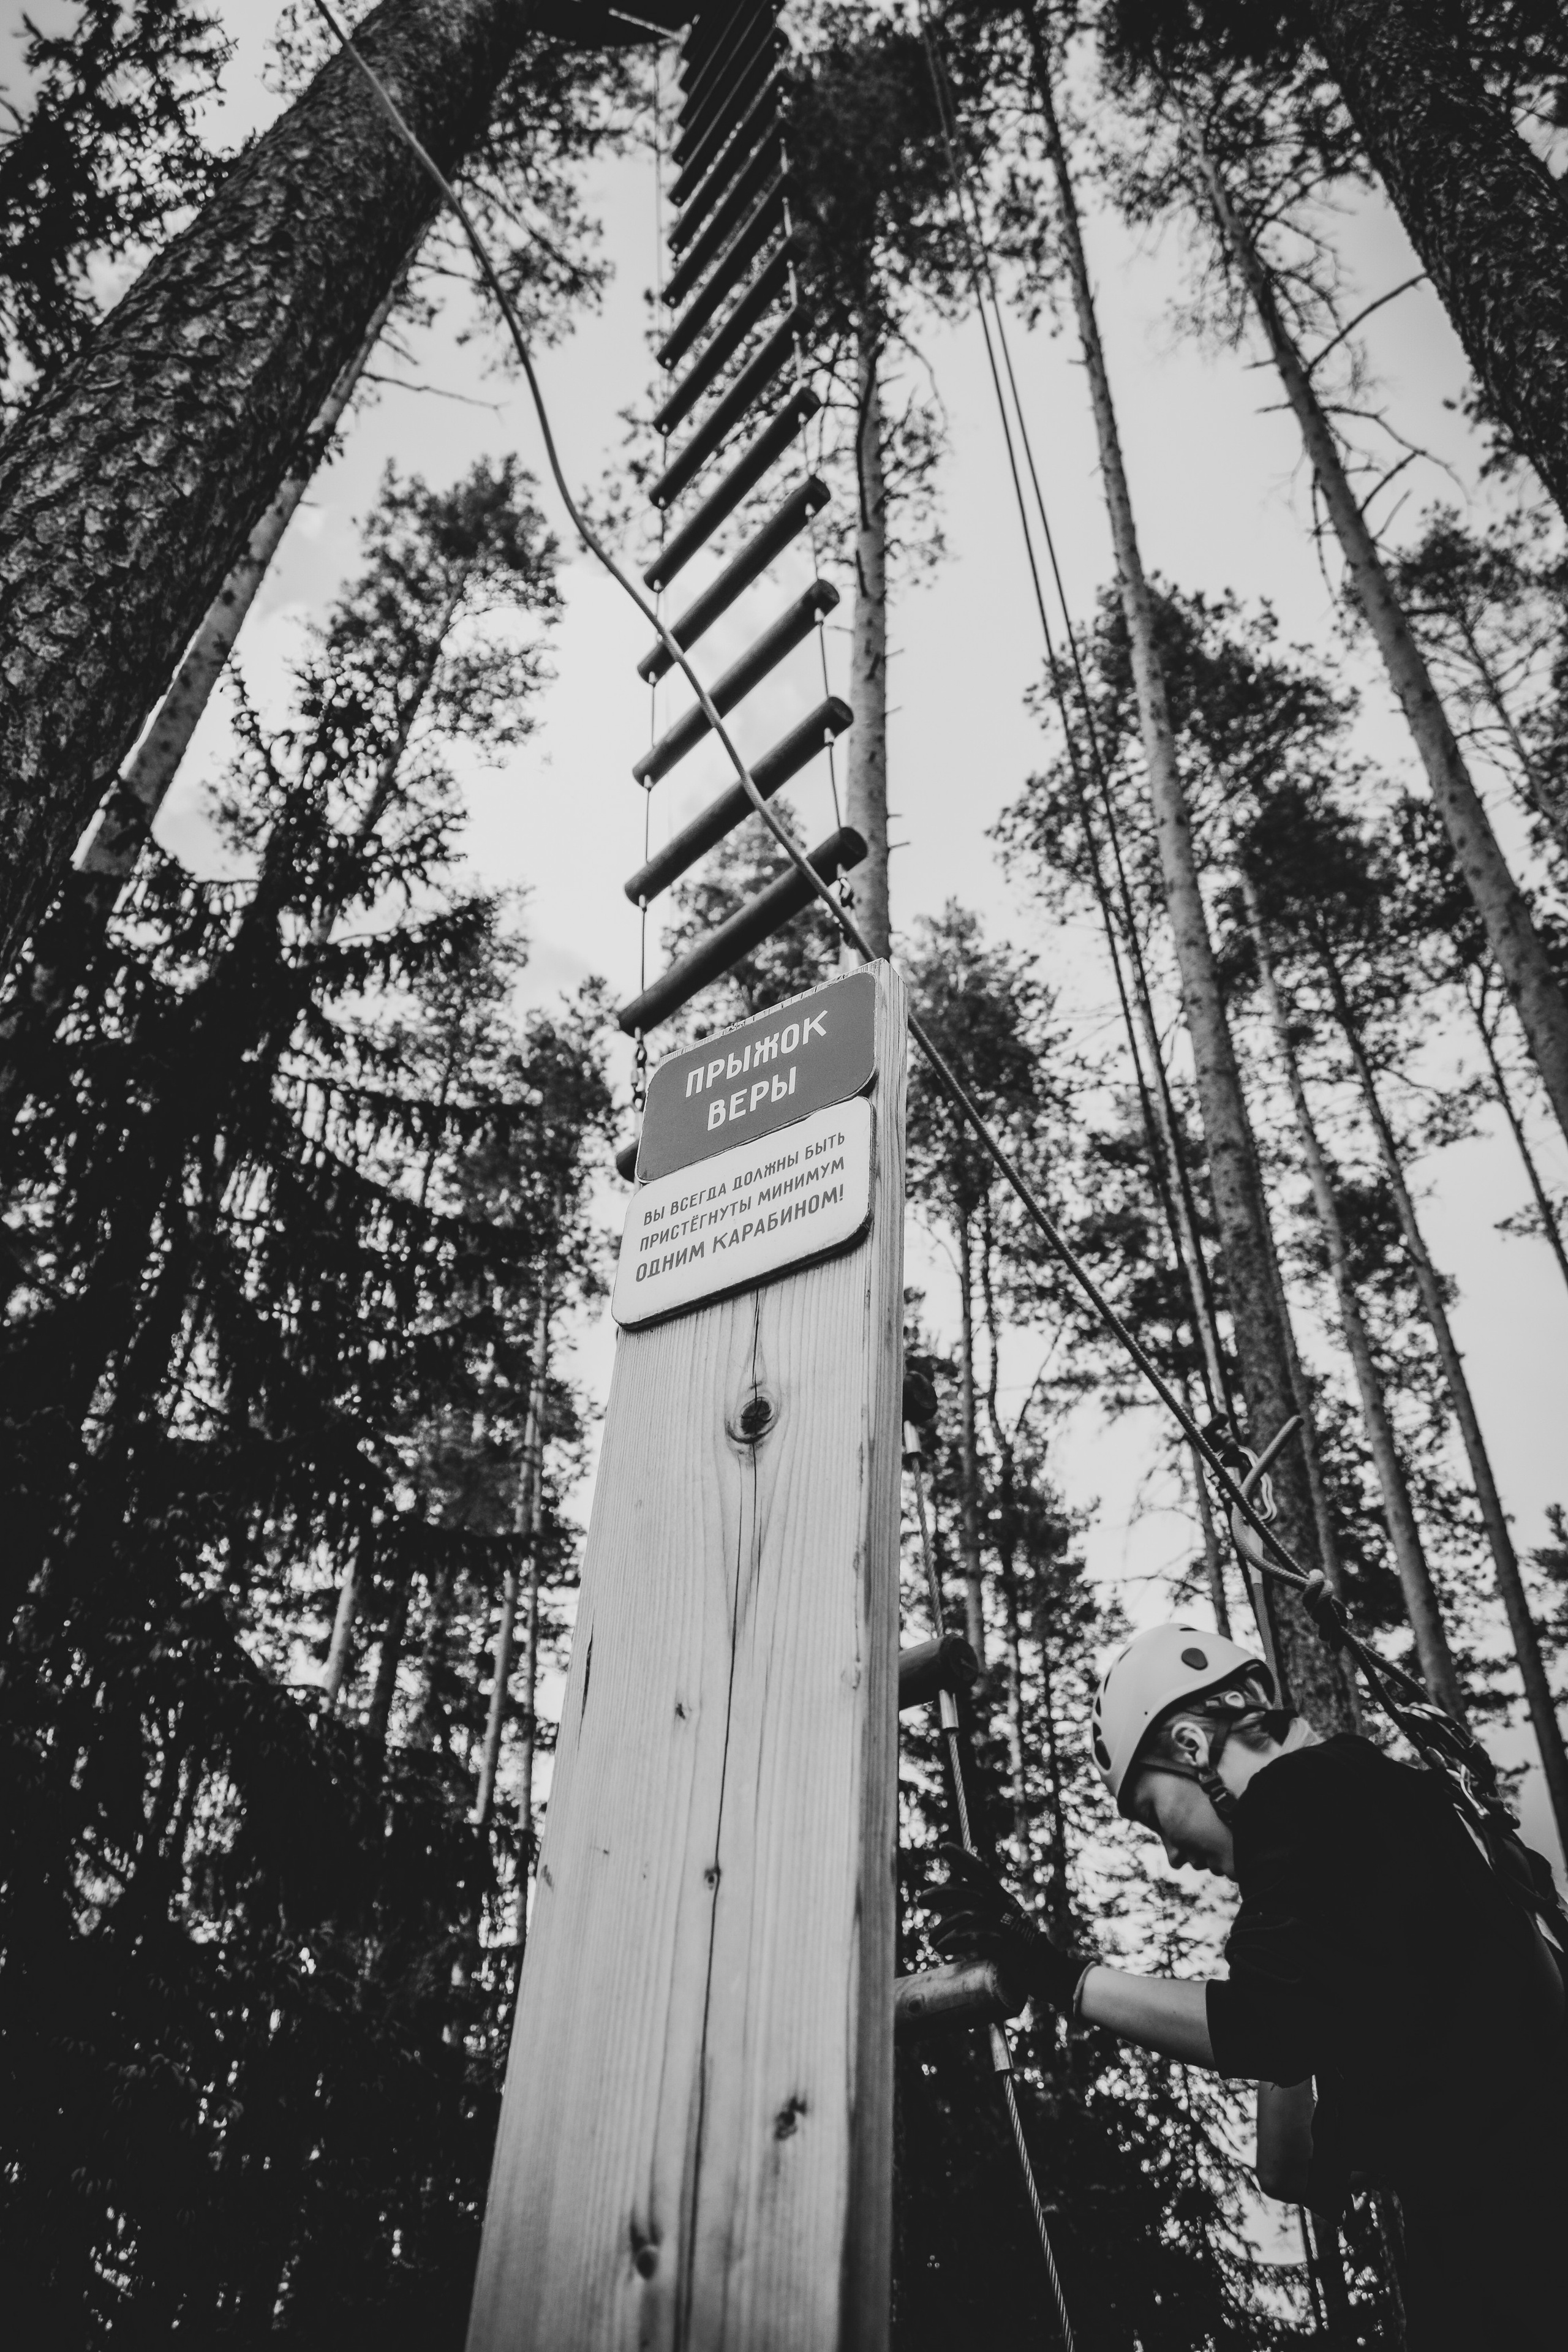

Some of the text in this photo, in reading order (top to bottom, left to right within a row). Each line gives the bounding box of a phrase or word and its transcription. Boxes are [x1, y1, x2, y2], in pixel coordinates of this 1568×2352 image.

[685, 1010, 828, 1098] ПРЫЖОК
[707, 1066, 796, 1131] ВЕРЫ
[639, 1156, 844, 1252] ПРИСТЁГНУТЫ МИНИМУМ
[644, 1132, 845, 1226] ВЫ ВСЕГДА ДОЛЖНЫ БЫТЬ
[636, 1183, 844, 1282] ОДНИМ КАРАБИНОМ!
